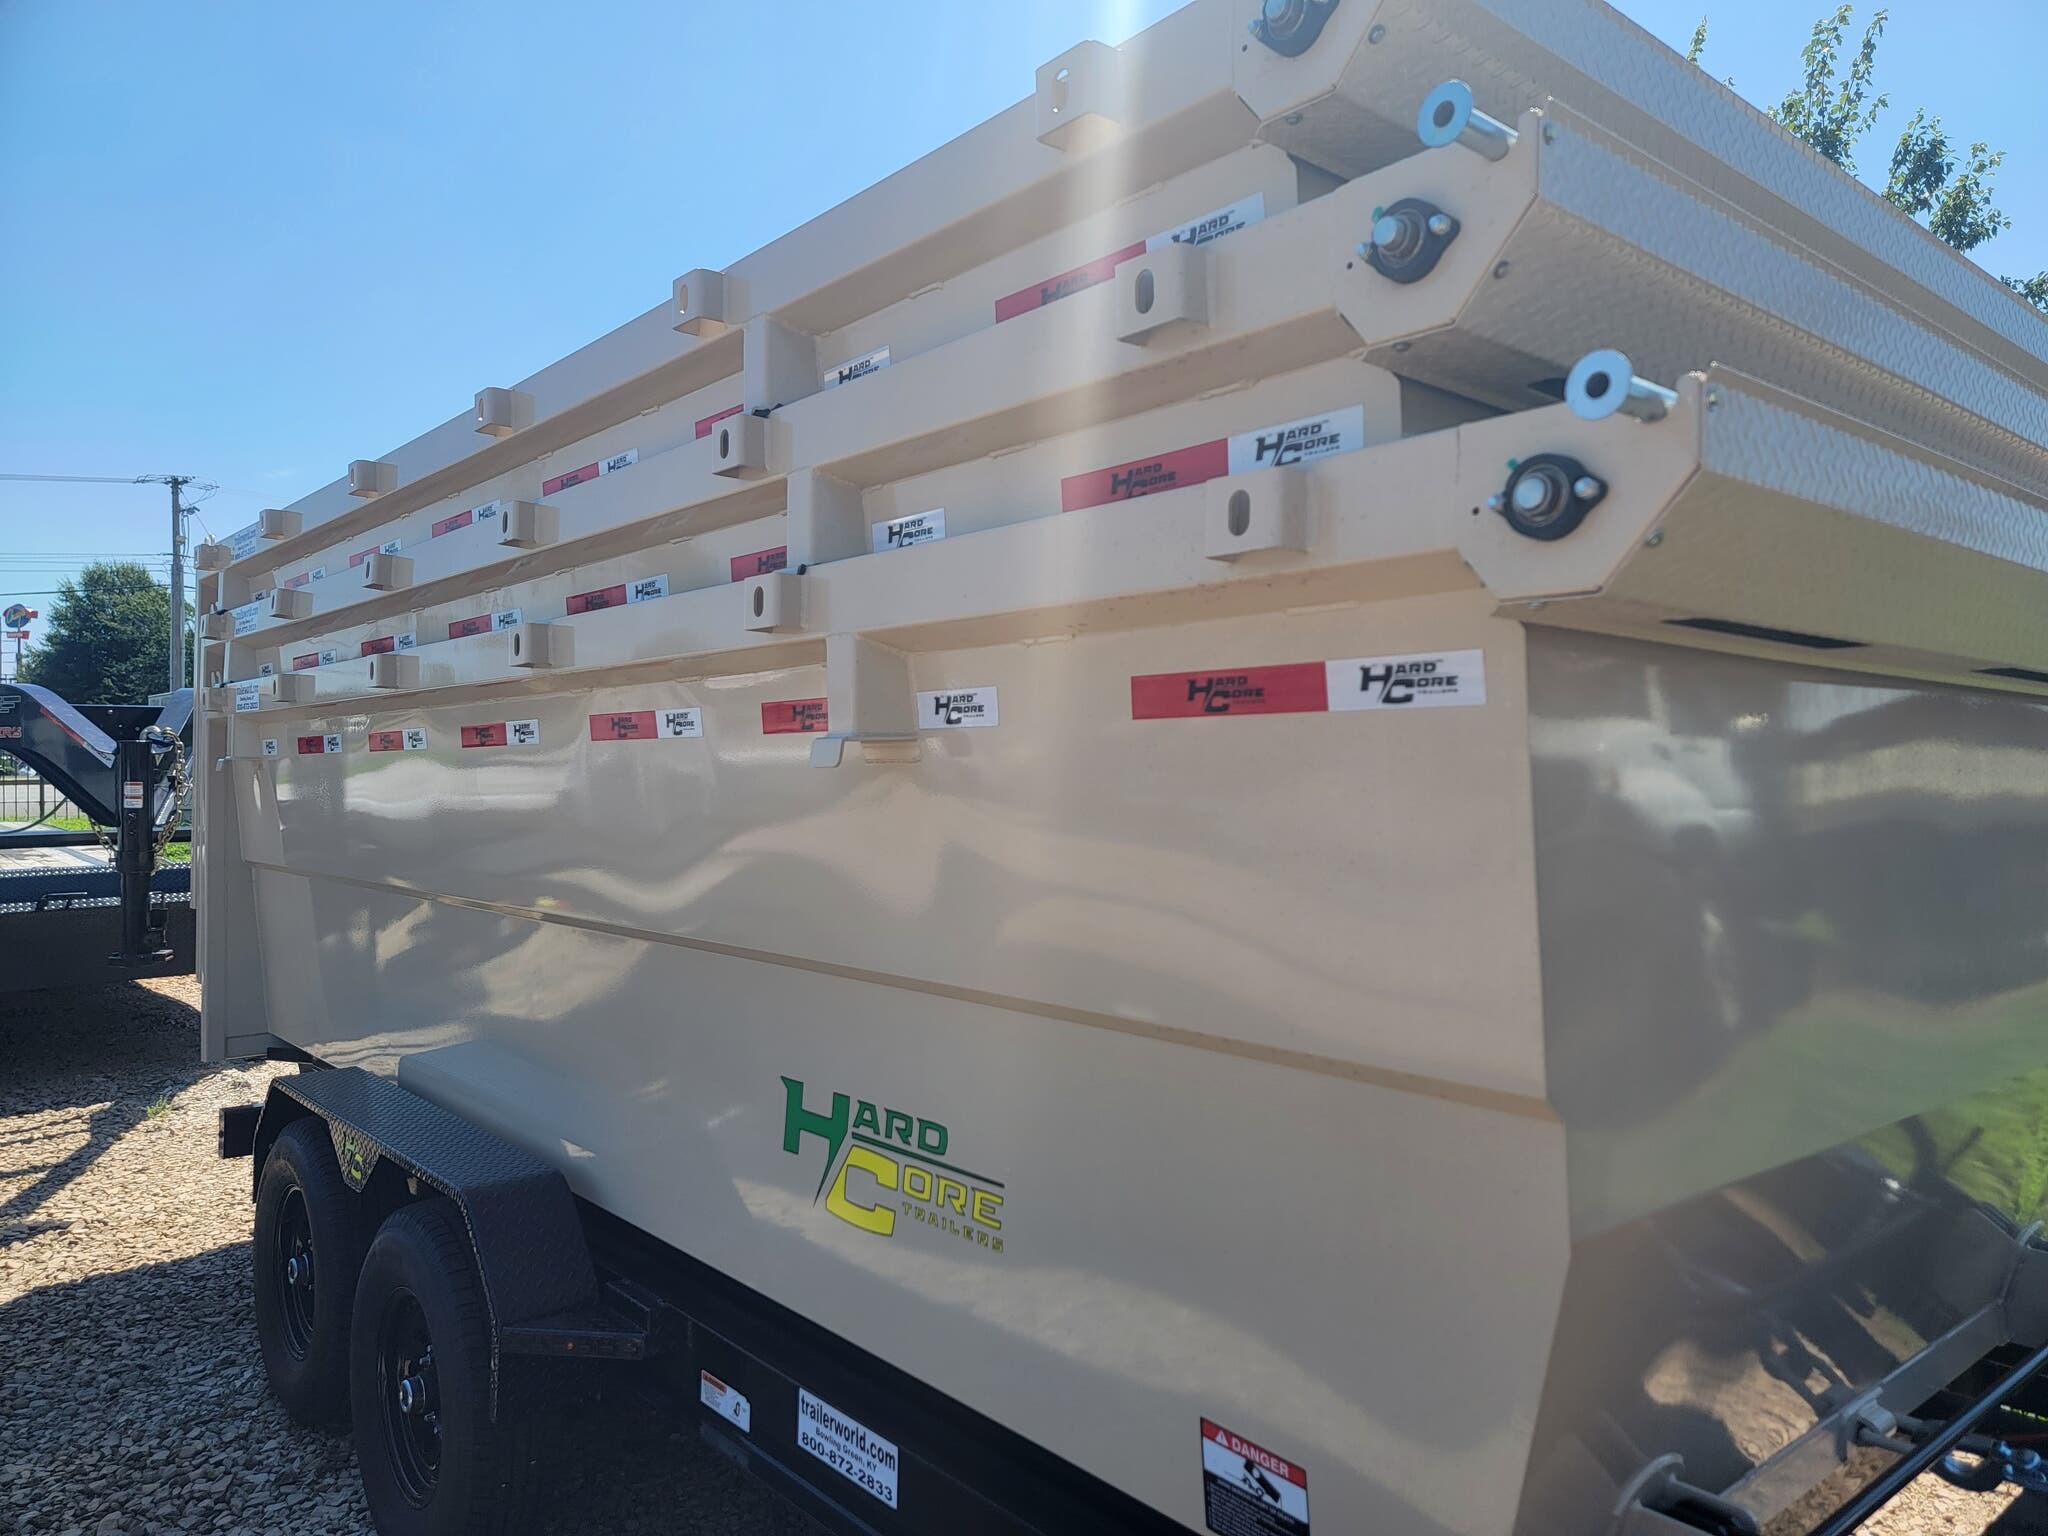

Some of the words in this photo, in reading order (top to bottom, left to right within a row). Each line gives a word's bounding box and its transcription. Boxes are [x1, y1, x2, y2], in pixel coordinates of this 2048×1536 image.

[1256, 424, 1322, 466] HARD
[888, 519, 924, 548] HARD
[1187, 676, 1248, 706] HARD
[1359, 662, 1437, 702] HARD
[1382, 676, 1459, 704] CORE
[934, 695, 974, 721] HARD
[946, 705, 985, 725] CORE
[780, 1075, 949, 1208] HARD
[825, 1144, 1004, 1237] CORE
[902, 1201, 1004, 1253] TRAILERS
[801, 1394, 896, 1471] trailerworld.com
[801, 1431, 893, 1502] 800-872-2833
[866, 1460, 877, 1473] KY
[1231, 1437, 1289, 1478] DANGER
